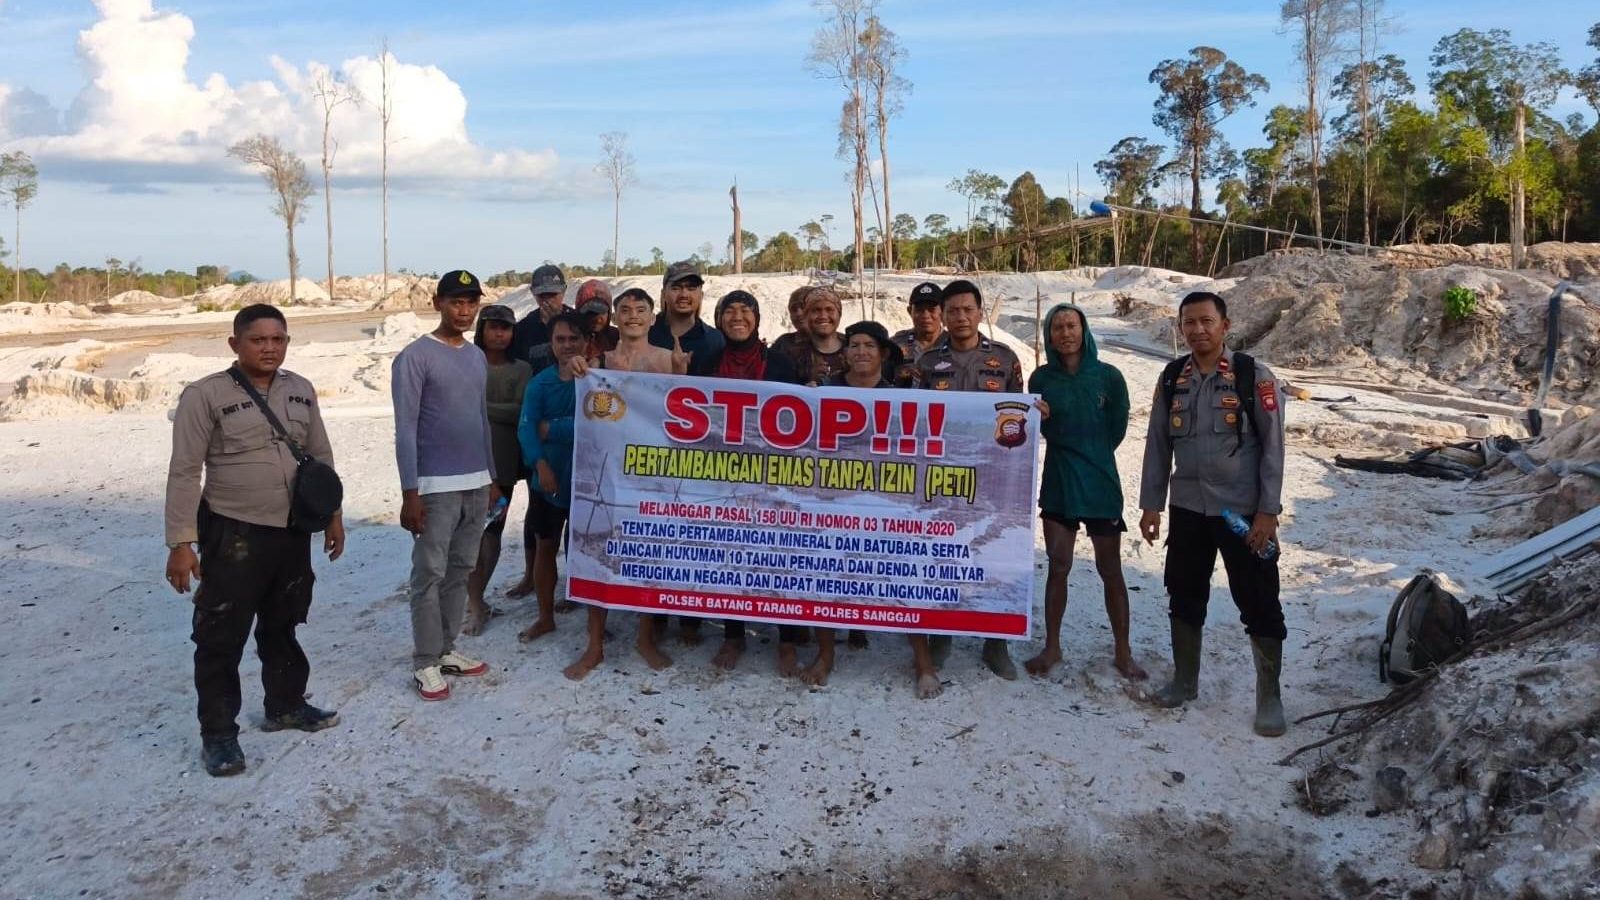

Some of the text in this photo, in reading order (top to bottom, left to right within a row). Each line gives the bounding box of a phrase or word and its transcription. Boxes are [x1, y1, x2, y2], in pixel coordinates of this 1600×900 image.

[664, 386, 946, 457] STOP!!!
[624, 444, 976, 504] PERTAMBANGAN EMAS TANPA IZIN (PETI)
[639, 501, 955, 536] MELANGGAR PASAL 158 UU RI NOMOR 03 TAHUN 2020
[622, 521, 970, 559] TENTANG PERTAMBANGAN MINERAL DAN BATUBARA SERTA
[607, 541, 984, 581] DI ANCAM HUKUMAN 10 TAHUN PENJARA DAN DENDA 10 MILYAR
[621, 564, 959, 602] MERUGIKAN NEGARA DAN DAPAT MERUSAK LINGKUNGAN
[658, 593, 703, 607] POLSEK
[706, 597, 752, 611] BATANG
[756, 601, 802, 615] TARANG
[813, 606, 859, 620] POLRES
[863, 609, 920, 624] SANGGAU
